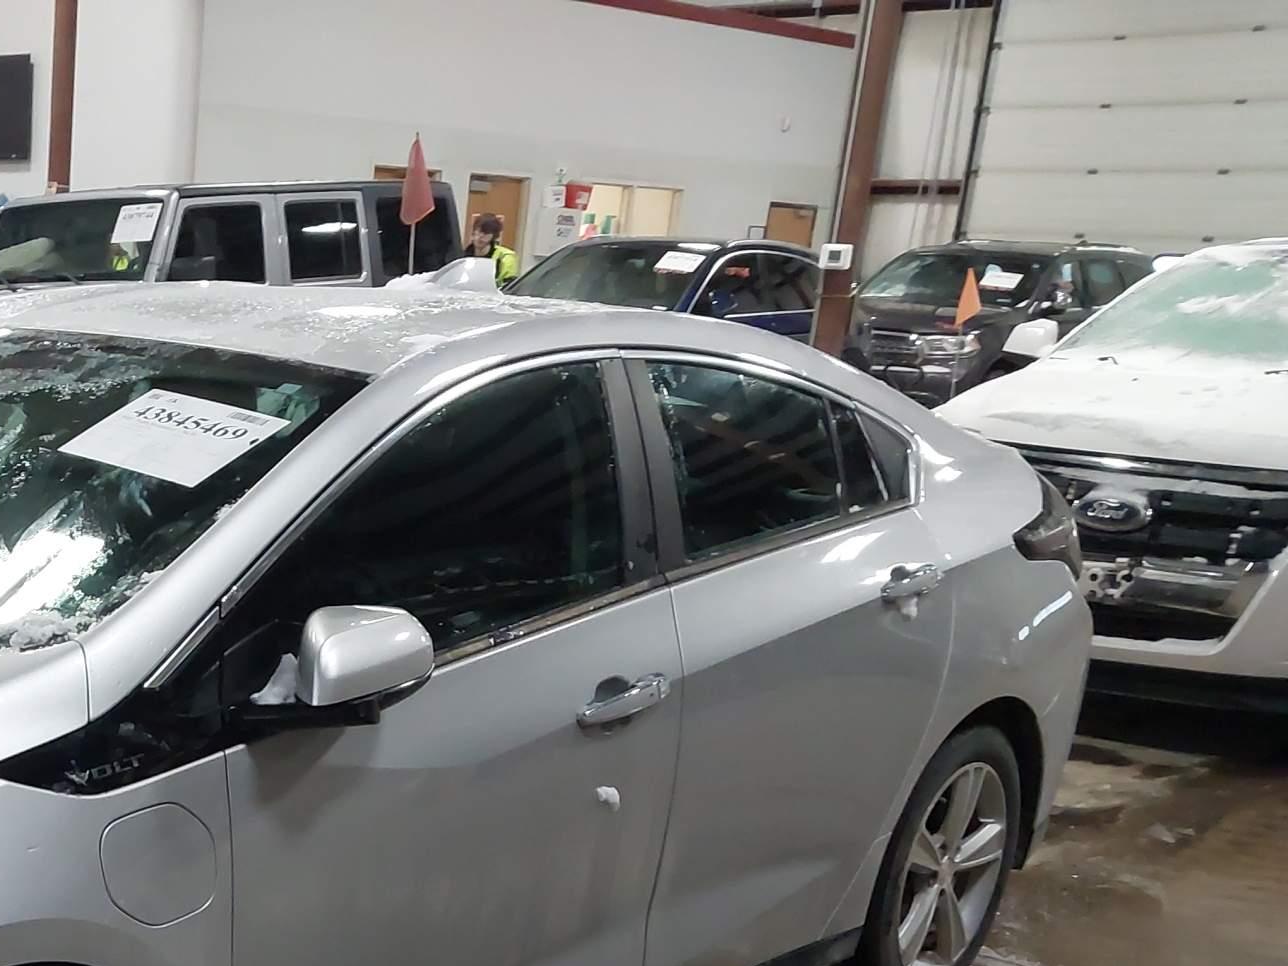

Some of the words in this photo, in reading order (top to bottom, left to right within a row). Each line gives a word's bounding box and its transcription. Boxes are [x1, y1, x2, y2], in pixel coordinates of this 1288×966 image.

[133, 405, 249, 440] 43845469
[1087, 498, 1129, 520] Ford
[65, 753, 144, 786] VOLT
